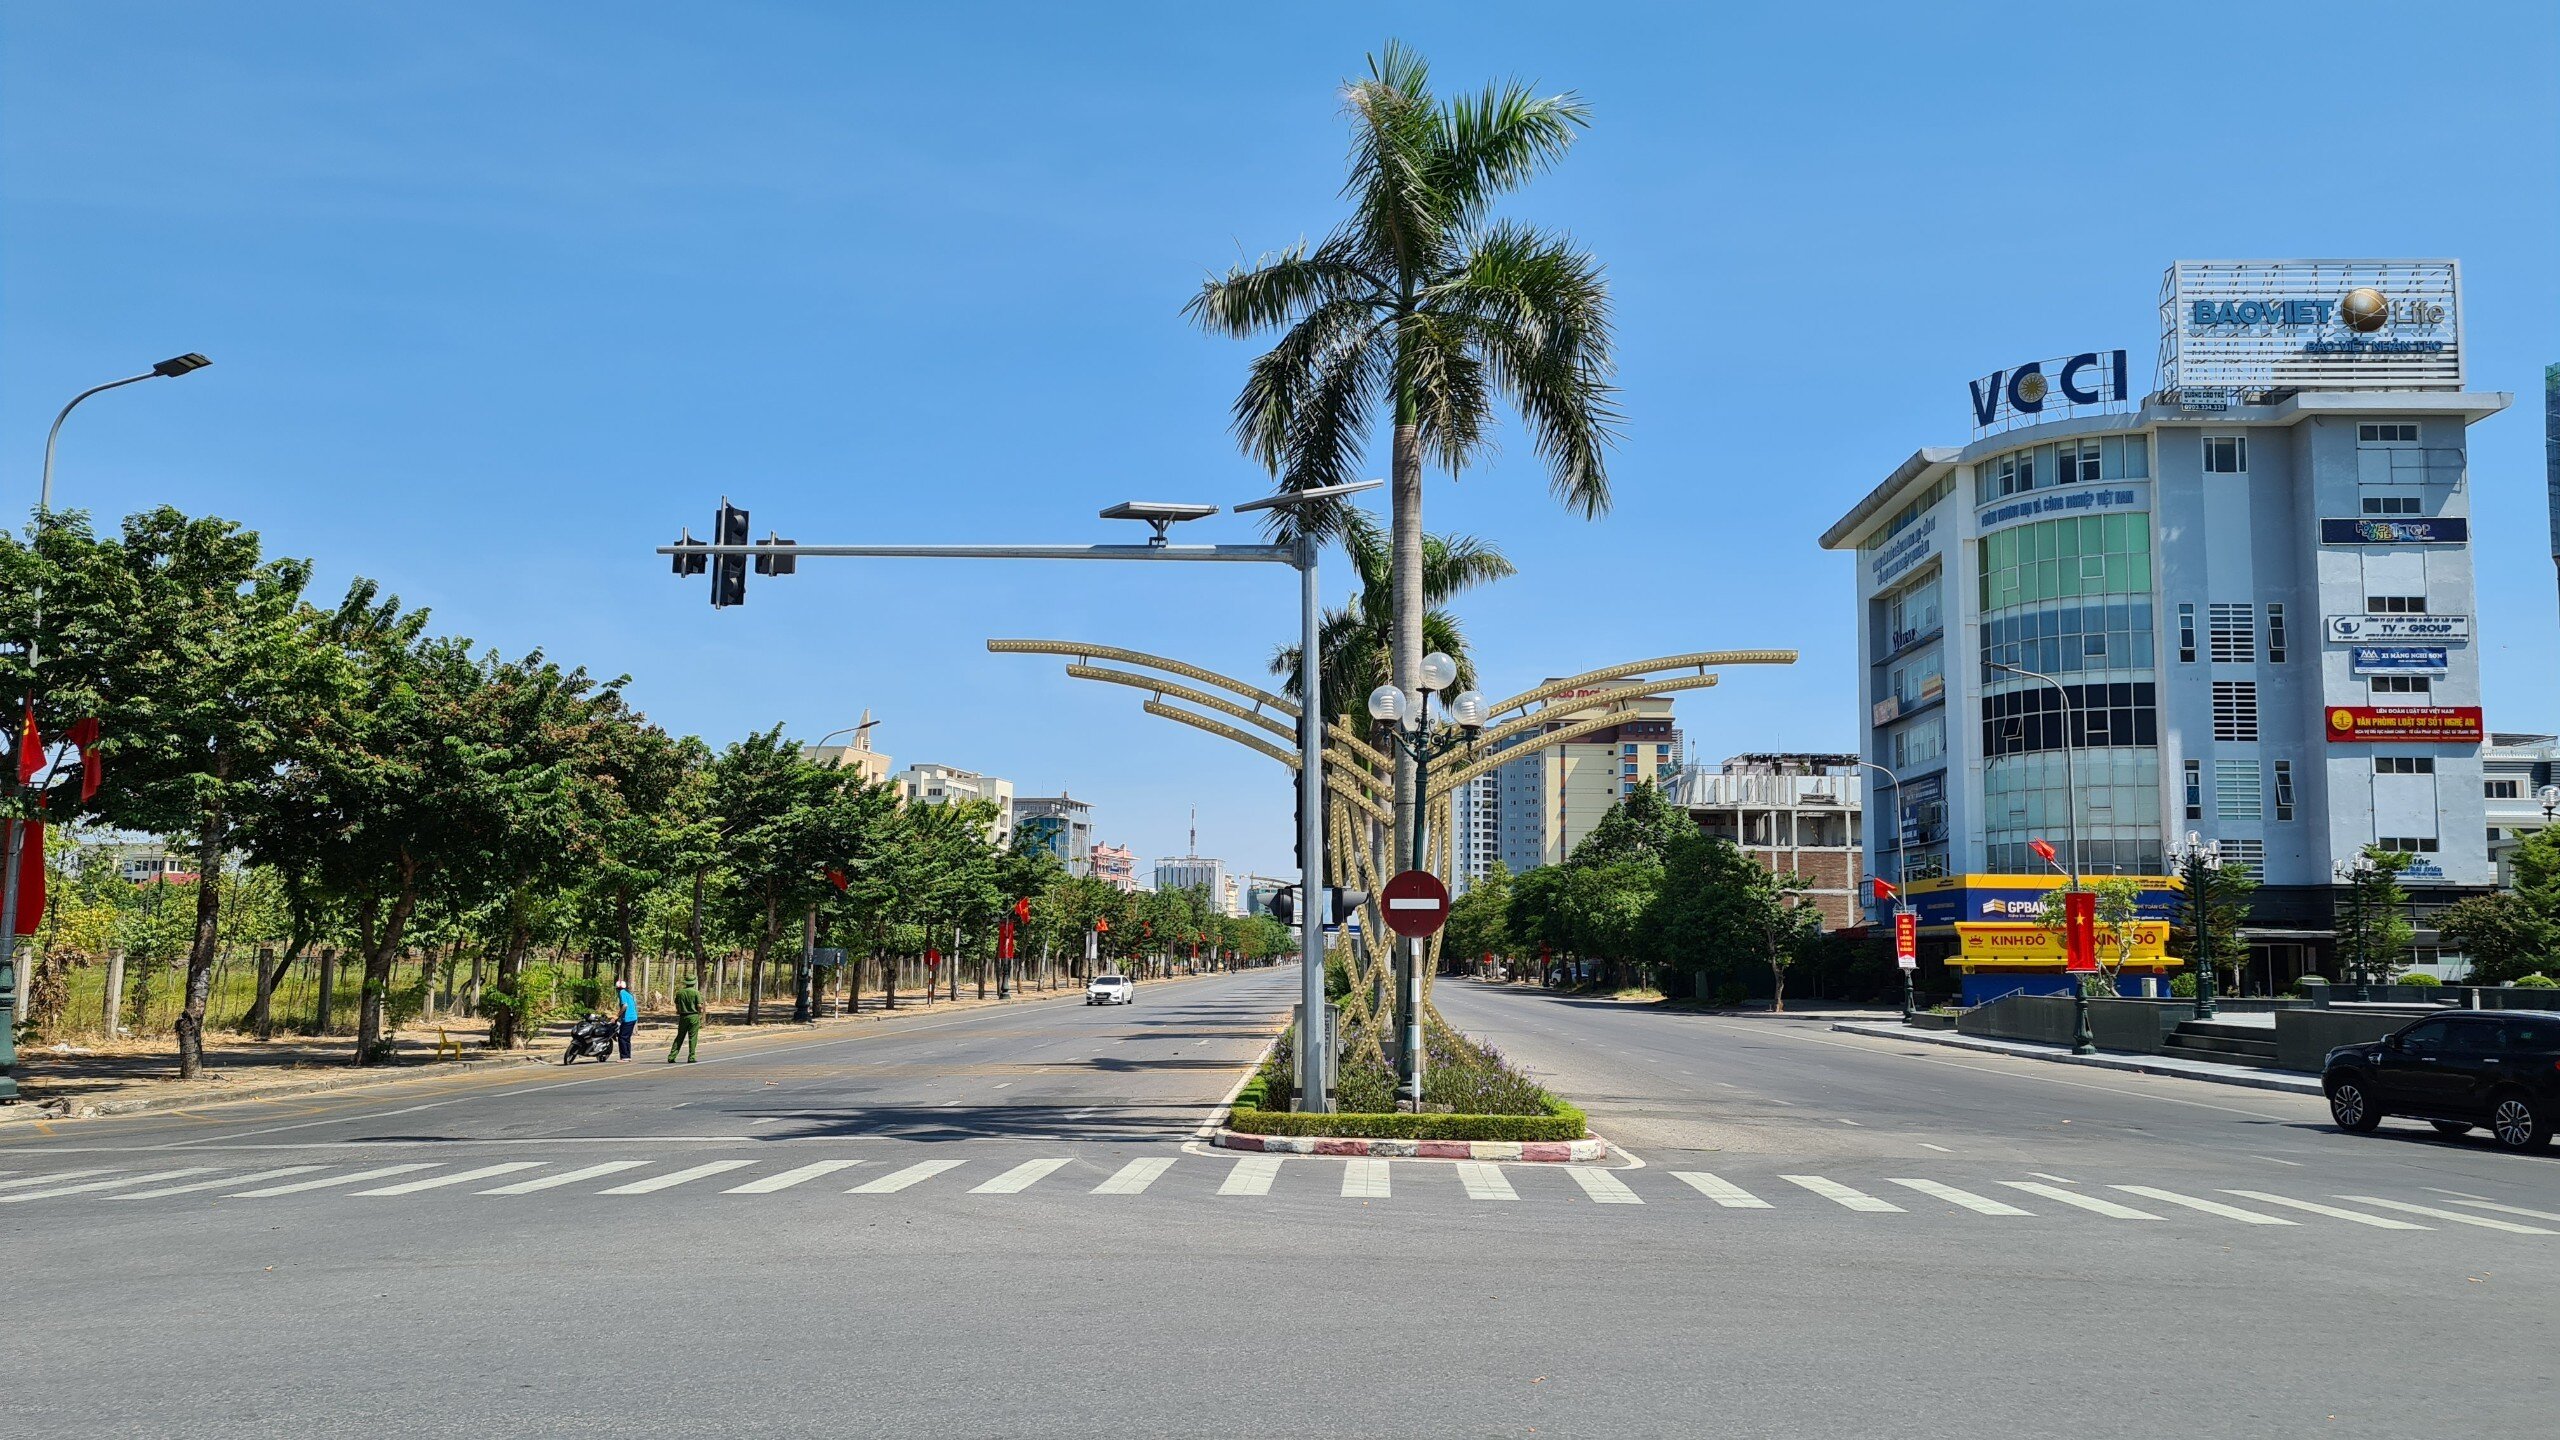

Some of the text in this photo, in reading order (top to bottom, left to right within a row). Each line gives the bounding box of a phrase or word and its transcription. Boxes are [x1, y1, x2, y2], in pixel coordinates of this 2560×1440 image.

[2194, 299, 2445, 325] BAOVIET Life
[2371, 337, 2411, 352] NHÂN
[2381, 624, 2397, 633] TV
[2408, 624, 2452, 633] GROUP
[2356, 716, 2371, 726] VĂN
[2372, 715, 2396, 726] PHÒNG
[2464, 717, 2475, 726] AN
[2008, 901, 2050, 914] GPBAN
[1991, 933, 2046, 946] KINH ĐÔ
